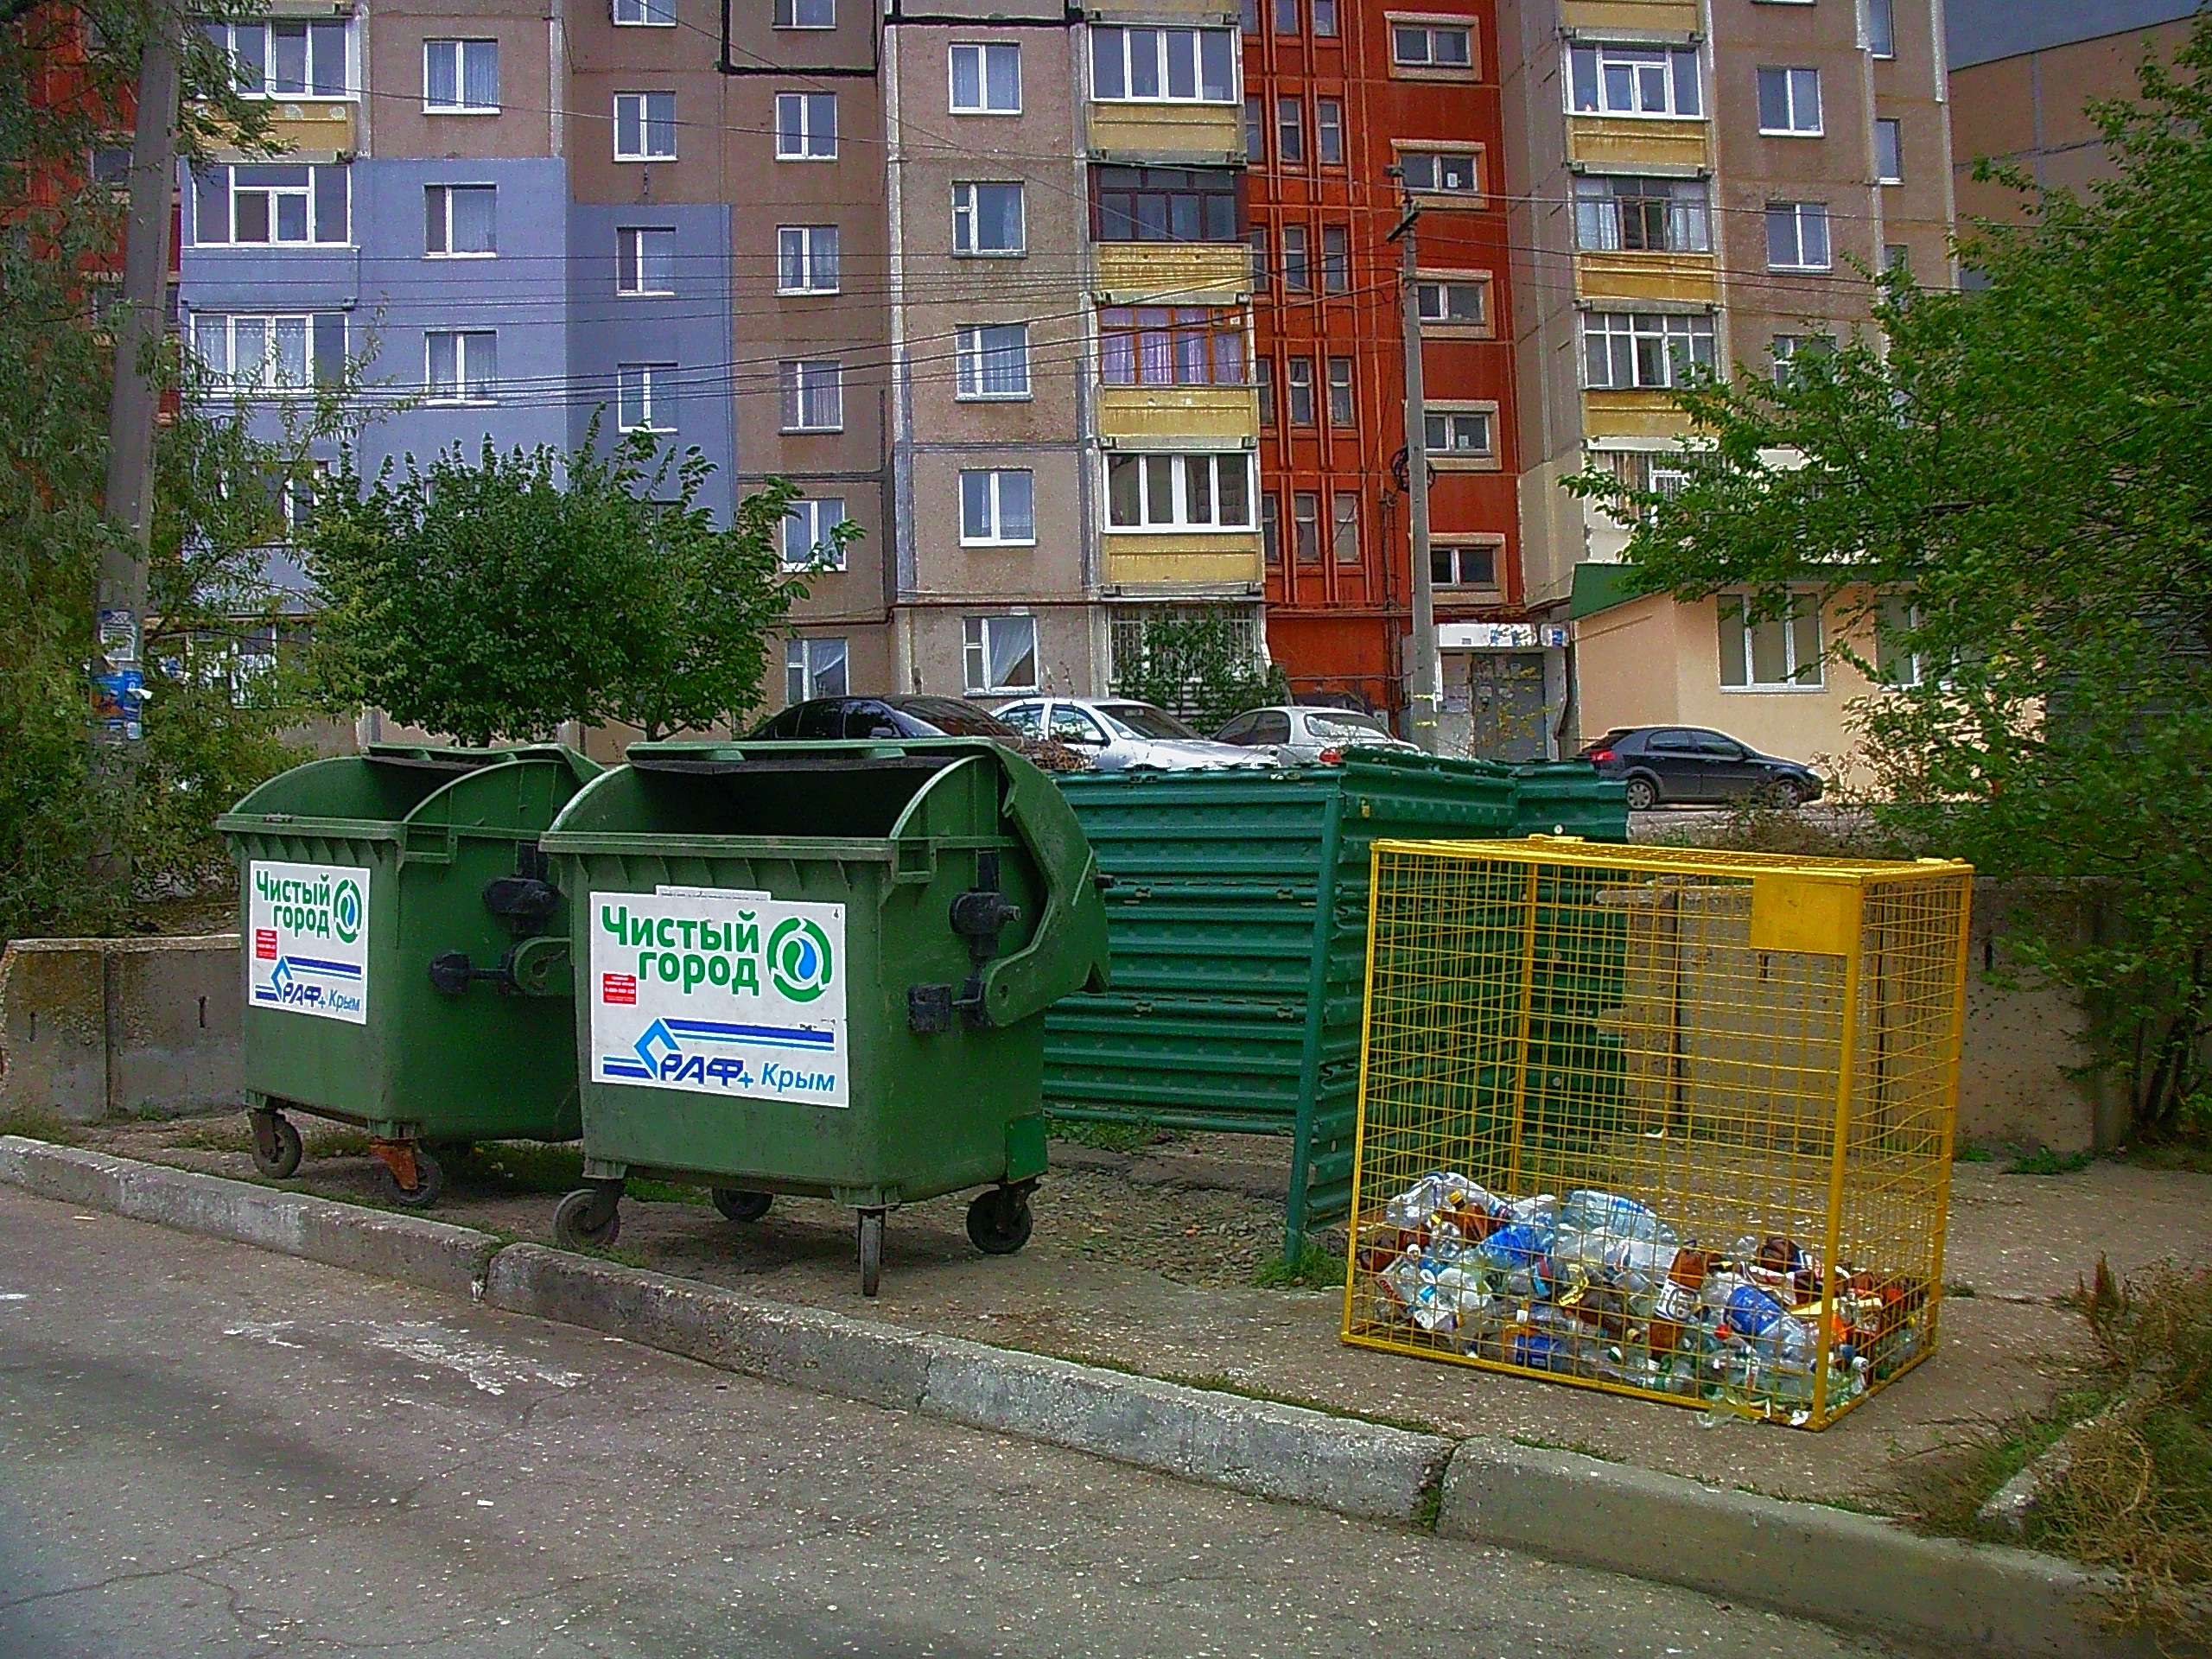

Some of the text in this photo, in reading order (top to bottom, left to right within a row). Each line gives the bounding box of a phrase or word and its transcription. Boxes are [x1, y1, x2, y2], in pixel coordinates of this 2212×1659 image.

[256, 870, 330, 906] Чистый
[273, 905, 330, 939] город
[601, 906, 760, 954] Чистый
[639, 951, 760, 997] город
[328, 988, 360, 1012] Крым
[761, 1062, 836, 1093] Крым
